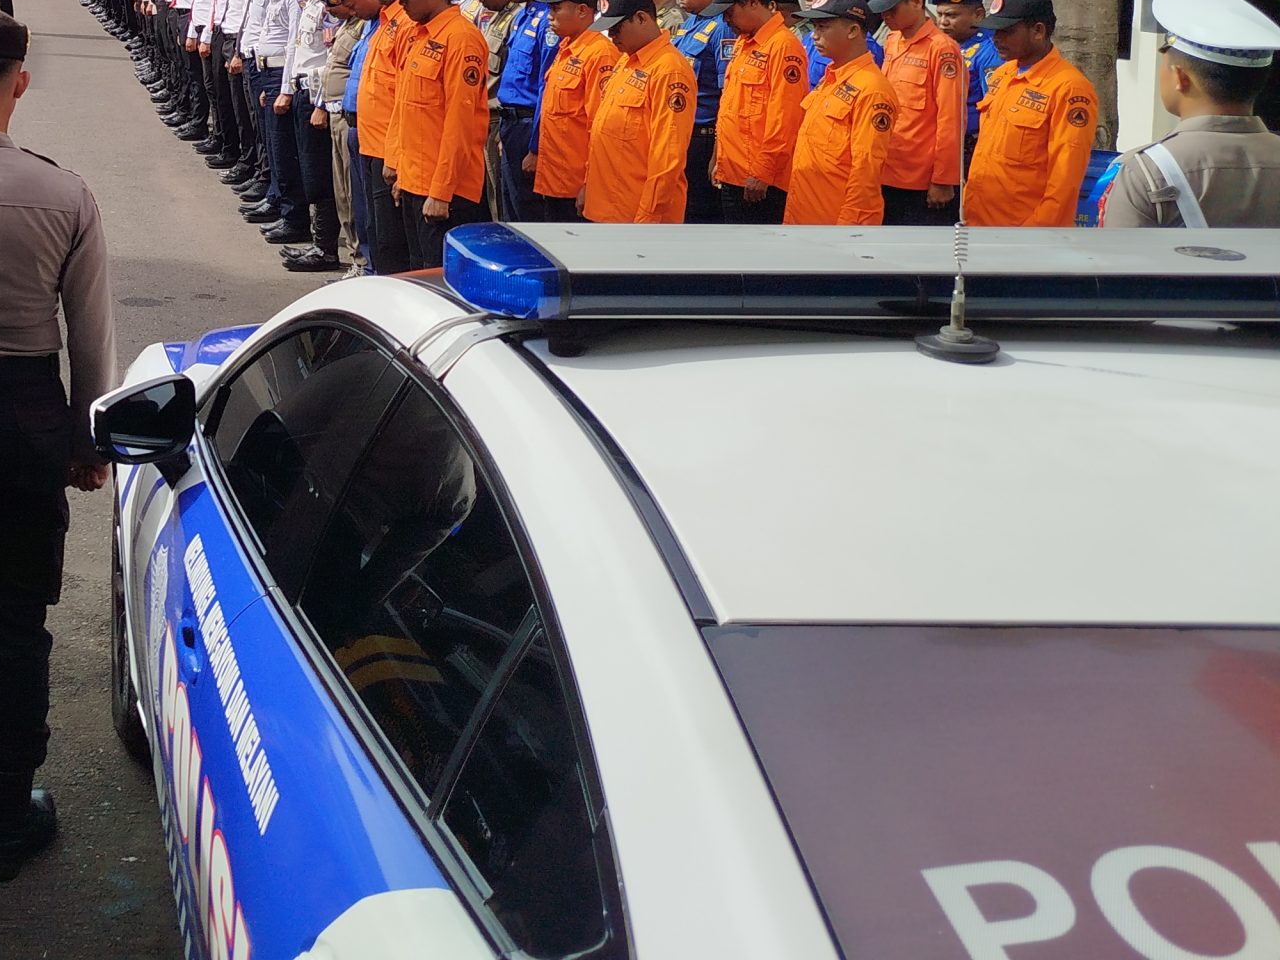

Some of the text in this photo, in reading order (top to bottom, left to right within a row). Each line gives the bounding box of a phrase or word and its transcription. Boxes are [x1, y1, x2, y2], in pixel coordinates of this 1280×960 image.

[225, 678, 251, 742] DAN
[235, 712, 280, 836] MELAYANI
[921, 841, 1280, 960] PO
